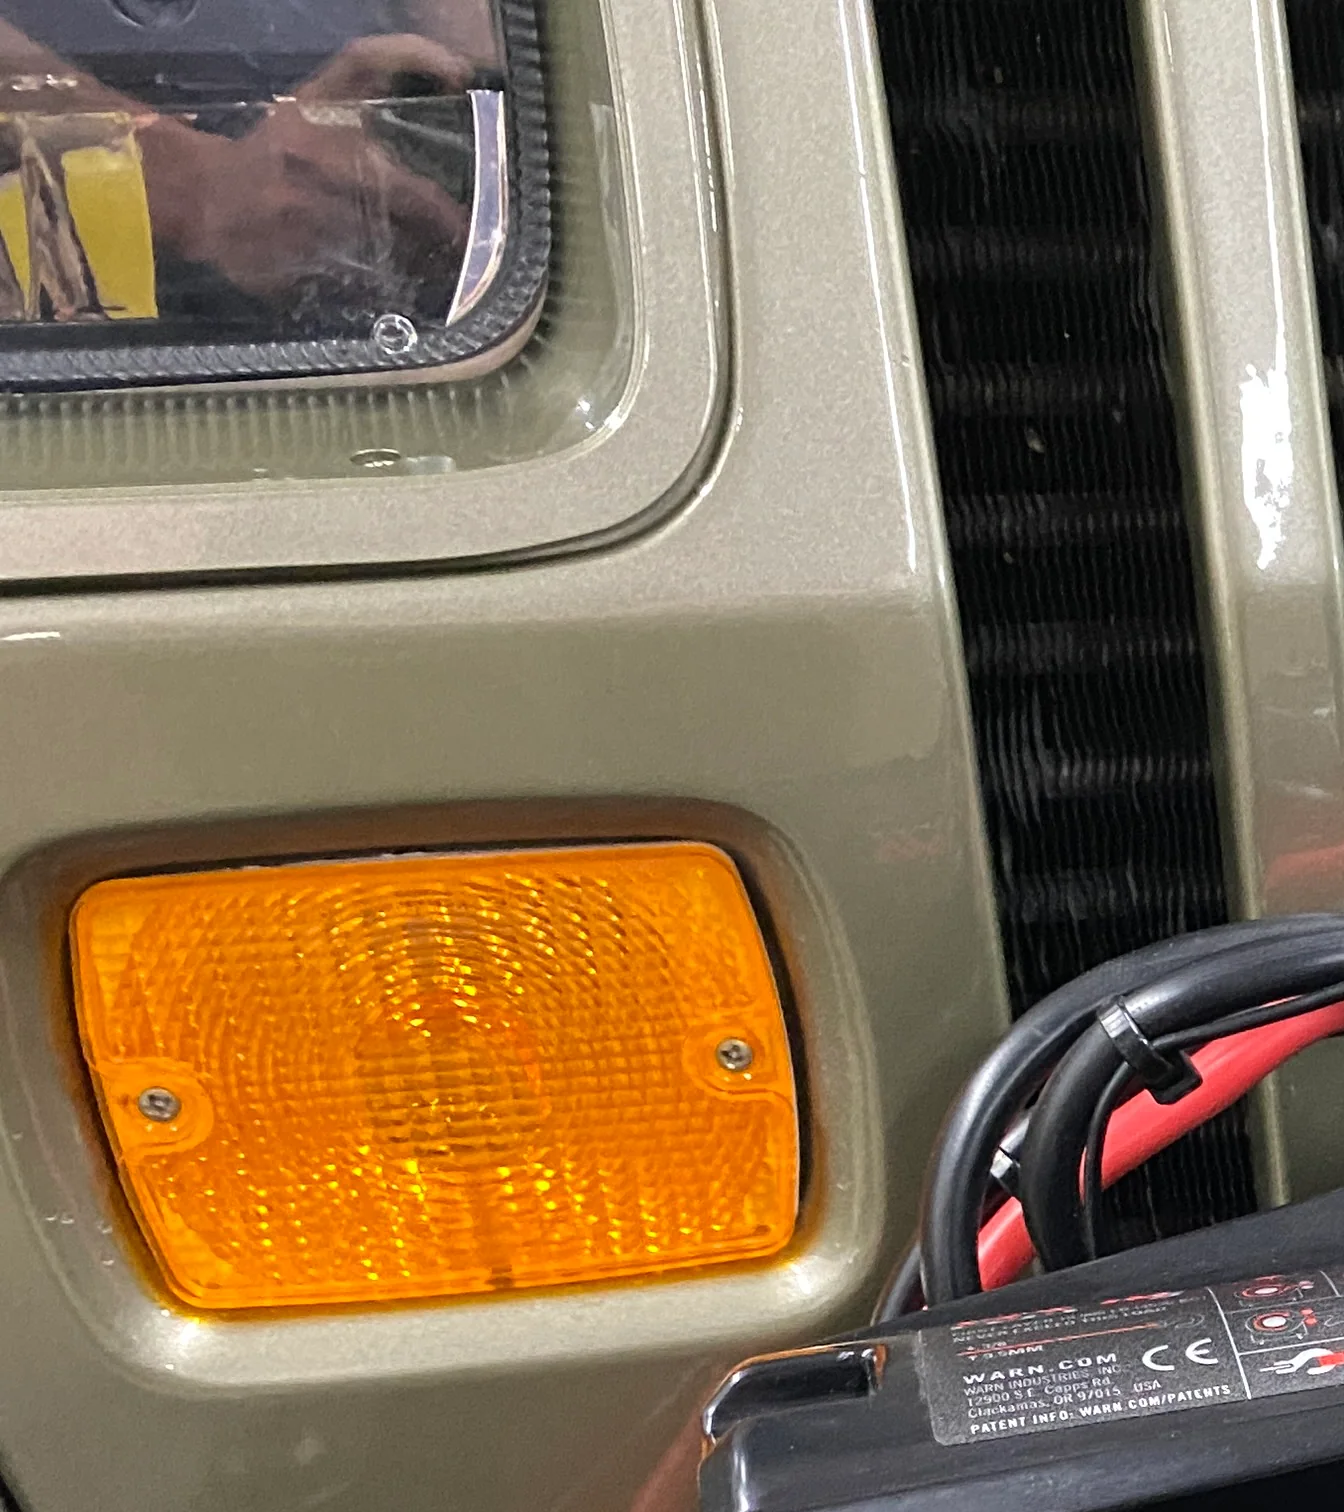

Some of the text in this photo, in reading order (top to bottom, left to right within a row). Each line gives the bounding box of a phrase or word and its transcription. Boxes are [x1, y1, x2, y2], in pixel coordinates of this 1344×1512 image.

[1141, 1337, 1219, 1371] CE
[963, 1353, 1117, 1385] WARN.COM
[964, 1383, 1004, 1396] WARN
[968, 1392, 1010, 1407] 12900
[1044, 1381, 1089, 1395] Capps
[1053, 1393, 1074, 1405] OR
[1077, 1385, 1121, 1401] 97015
[1133, 1380, 1162, 1393] USA
[970, 1384, 1231, 1435] PATENT INFO: WARN.COM/PATENTS
